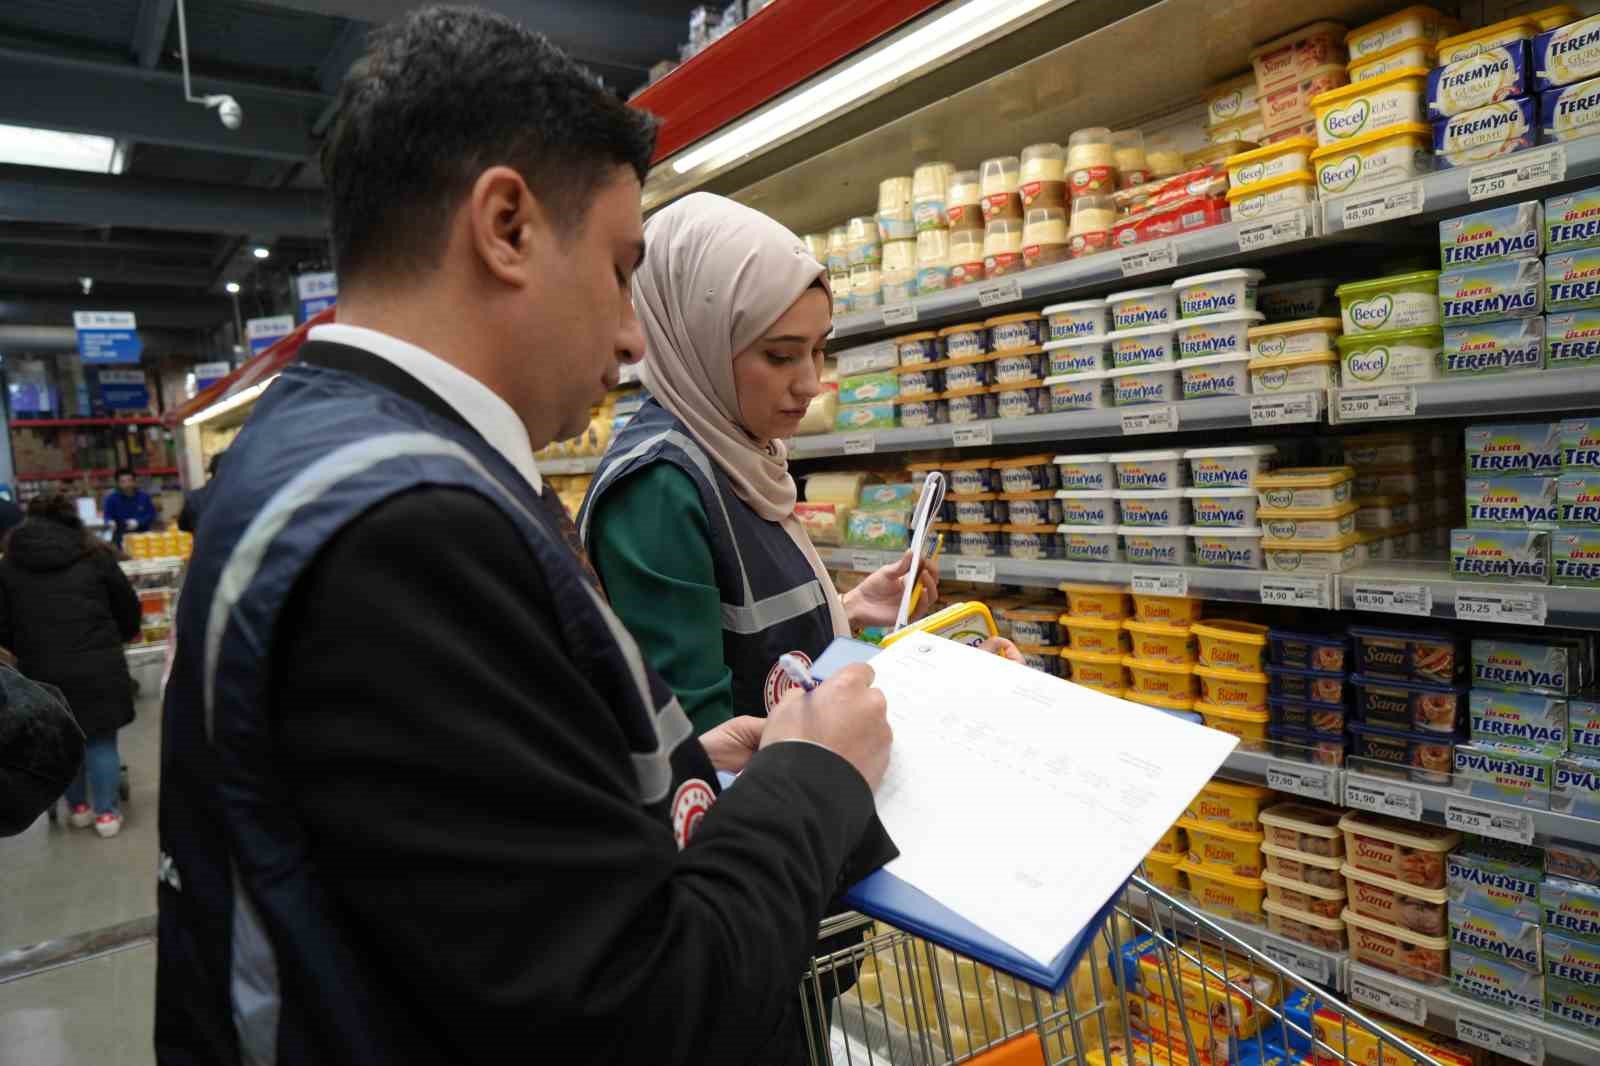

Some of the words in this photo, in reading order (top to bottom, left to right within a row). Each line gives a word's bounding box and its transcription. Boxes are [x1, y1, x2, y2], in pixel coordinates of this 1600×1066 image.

[1329, 108, 1365, 130] Becel
[1322, 164, 1357, 184] Becel
[1457, 230, 1494, 244] ÜLKER
[1355, 304, 1387, 321] Becel
[1460, 341, 1496, 352] ÜLKER
[1352, 357, 1384, 371] Becel
[1145, 605, 1170, 619] Bizim
[1459, 602, 1490, 613] 28,25
[1143, 642, 1168, 657] Bizim
[1211, 647, 1240, 662] Bizim
[1365, 647, 1404, 665] Sana
[1144, 678, 1169, 691] Bizim
[1218, 686, 1248, 701] Bizim
[1367, 695, 1407, 712] Sana
[1365, 743, 1405, 760] Sana
[1201, 802, 1232, 817] Bizim
[1205, 846, 1234, 860] Bizim
[1358, 843, 1393, 864] Sana
[1358, 889, 1393, 910] Sana
[1358, 936, 1395, 957] Sana
